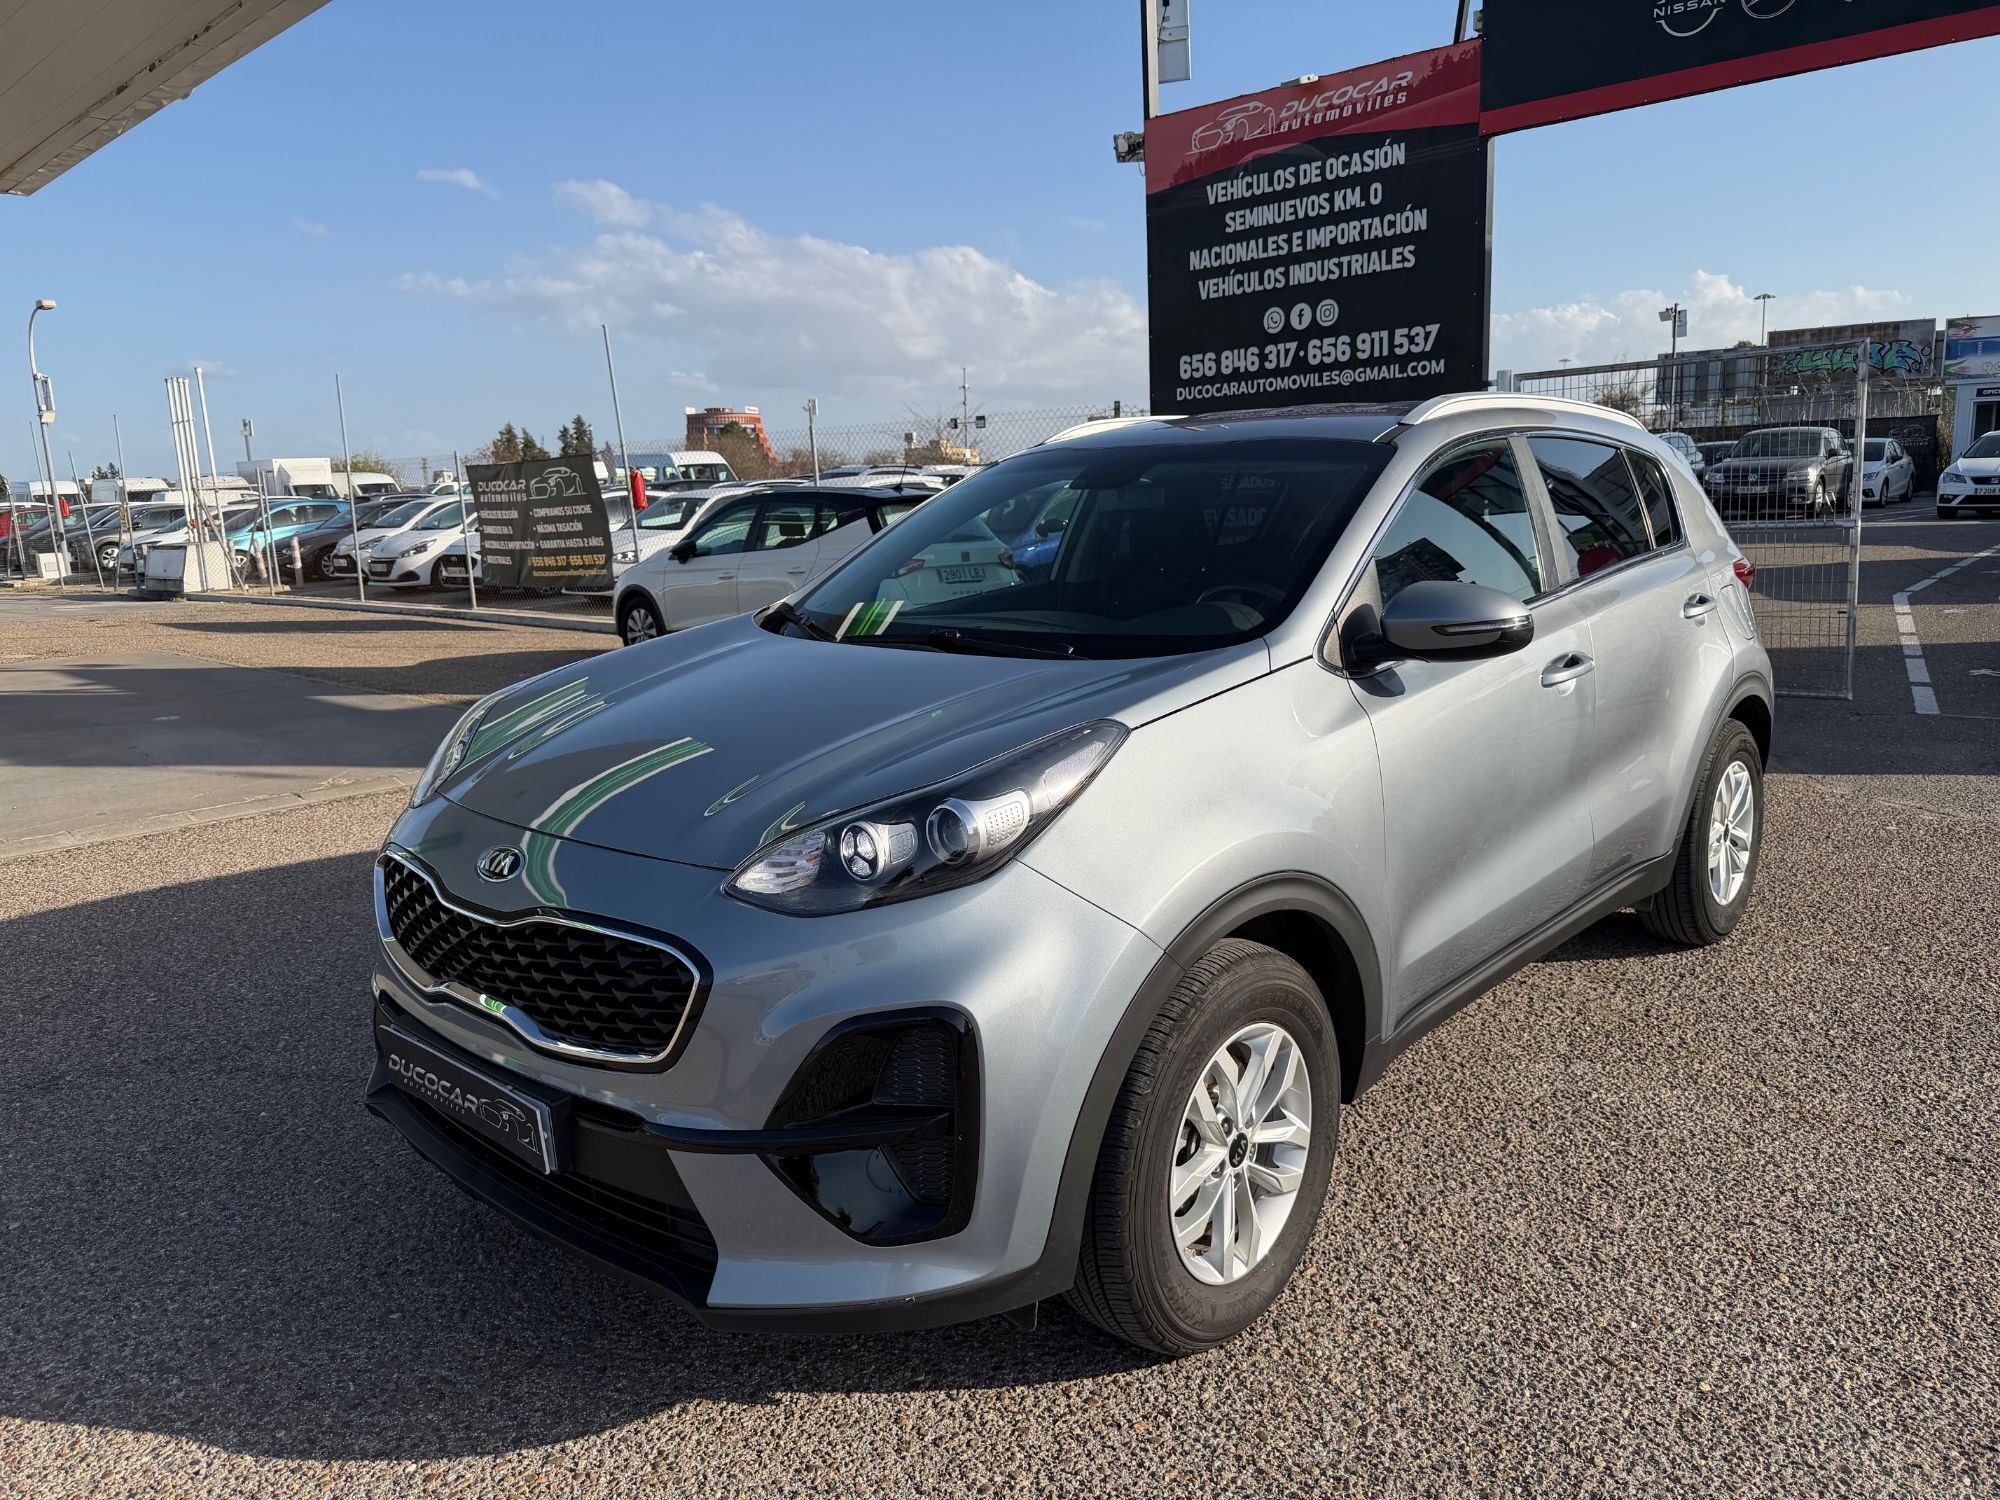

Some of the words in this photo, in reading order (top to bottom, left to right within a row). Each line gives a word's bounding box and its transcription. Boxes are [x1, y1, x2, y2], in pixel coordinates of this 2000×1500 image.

[1280, 70, 1413, 118] DUCOCAR
[1206, 165, 1296, 205] VEHÍCULOS
[1299, 161, 1322, 185] DE
[1325, 142, 1406, 182] OCASIÓN
[1224, 192, 1330, 234] SEMINUEVOS
[1334, 188, 1367, 212] KM.
[1189, 233, 1288, 272] NACIONALES
[1292, 230, 1303, 253] E
[1306, 205, 1428, 251] IMPORTACIÓN
[1198, 264, 1286, 300] VEHÍCULOS
[1288, 245, 1416, 286] INDUSTRIALES
[1179, 353, 1217, 380] 656
[1220, 346, 1260, 375] 846
[1356, 329, 1389, 358] 911
[1393, 324, 1441, 355] 537
[1176, 359, 1445, 401] DUCOCARAUTOMOVILES@GMAIL.COM
[478, 479, 526, 491] DUCOCAR
[533, 506, 565, 518] COMPRAMOS
[564, 505, 573, 515] SU
[572, 504, 593, 514] COCHE
[566, 538, 584, 548] HASTA
[583, 537, 589, 547] 2
[943, 568, 967, 581] 2901
[968, 567, 986, 579] LRJ
[388, 1053, 479, 1114] DUCOCAR
[1232, 1139, 1247, 1165] KIA
